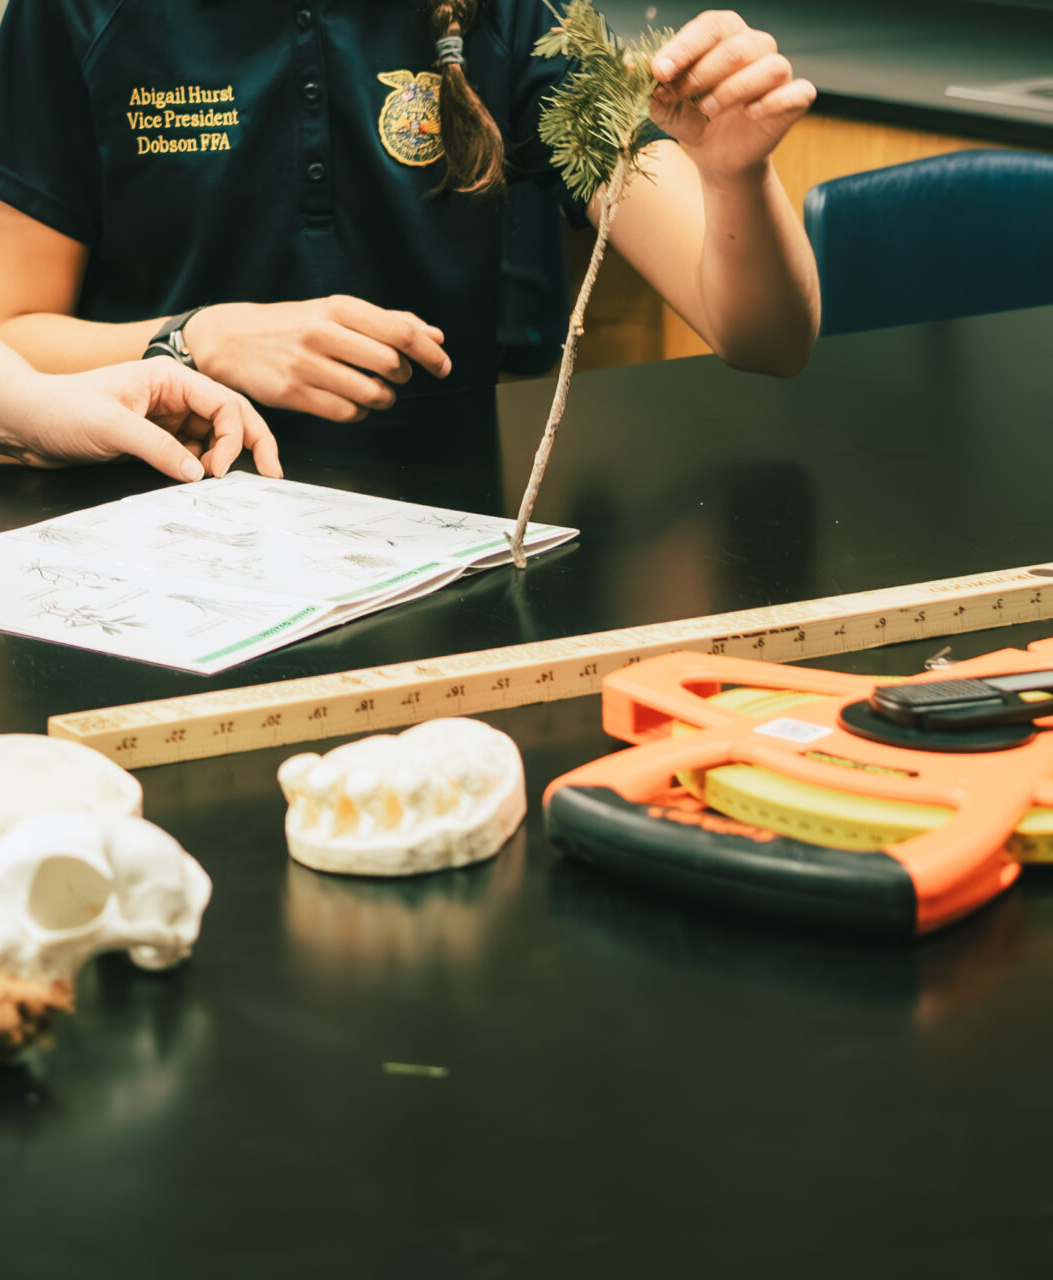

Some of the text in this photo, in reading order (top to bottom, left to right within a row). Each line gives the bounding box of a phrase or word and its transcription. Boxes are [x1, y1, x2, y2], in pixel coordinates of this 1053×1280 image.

[129, 85, 235, 109] Abigail Hurst
[126, 108, 240, 130] Vice President
[137, 131, 231, 155] Dobson FFA
